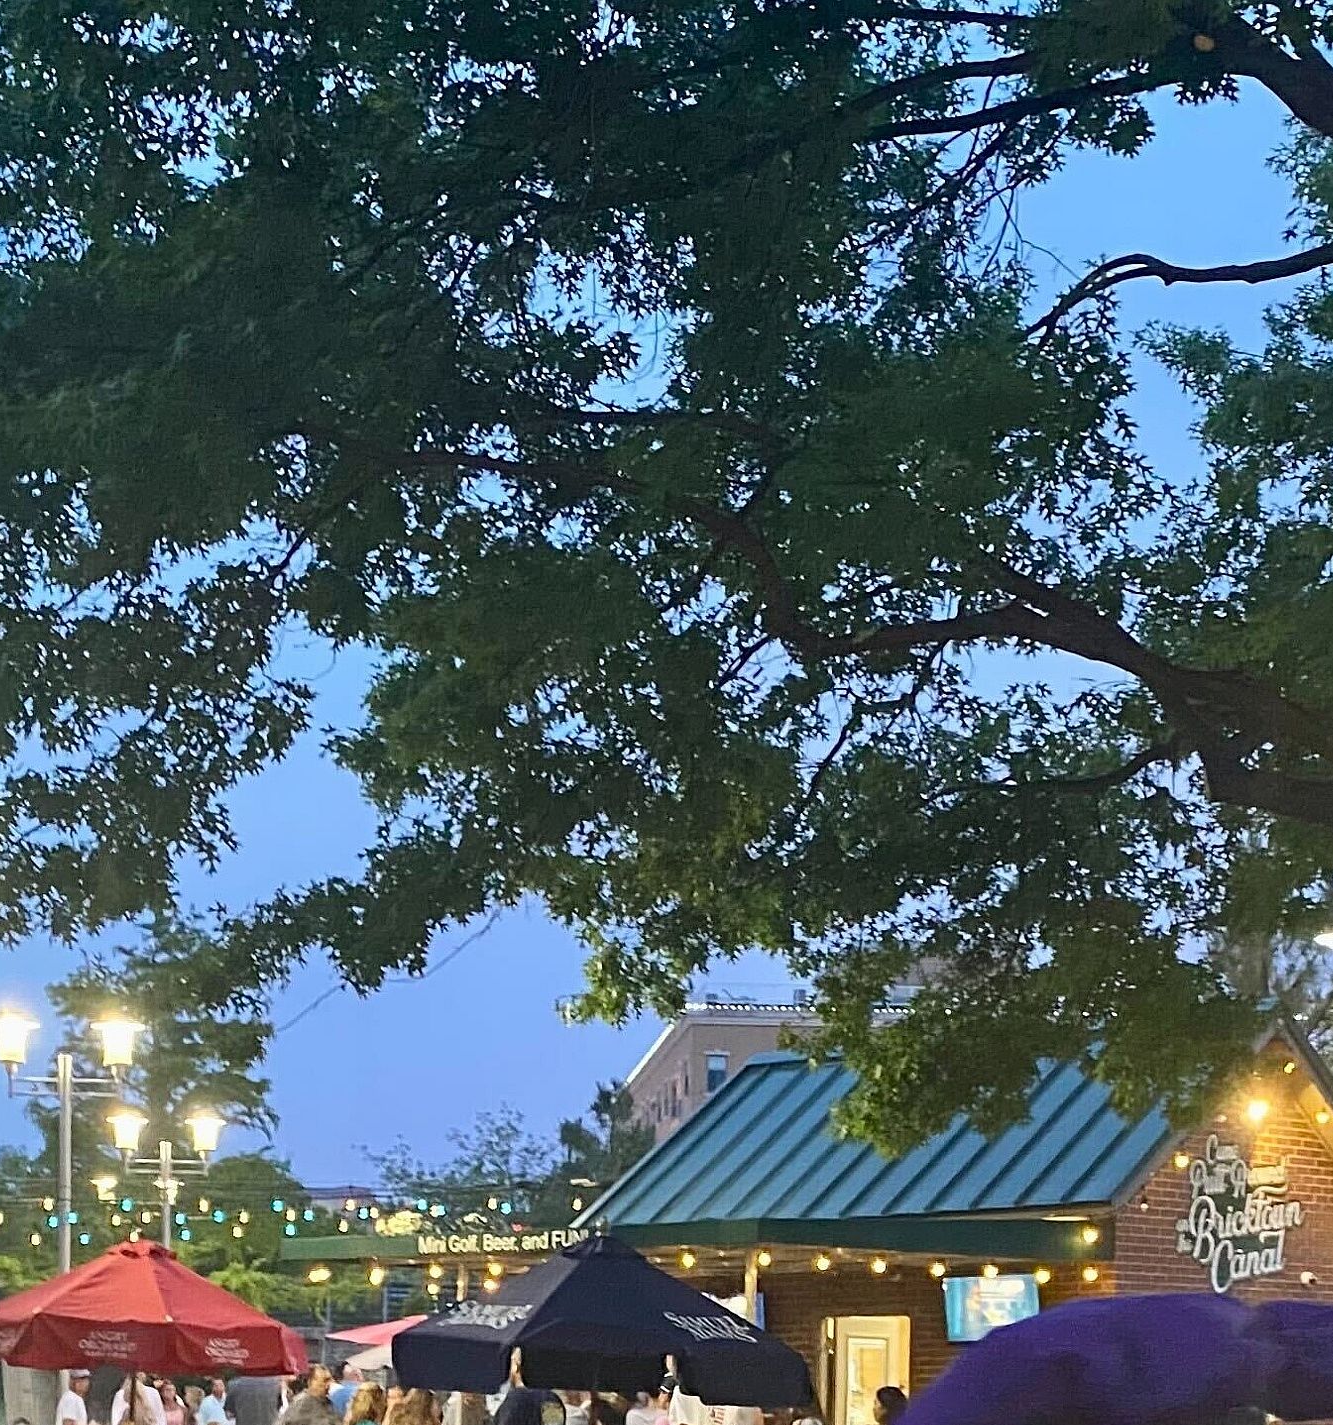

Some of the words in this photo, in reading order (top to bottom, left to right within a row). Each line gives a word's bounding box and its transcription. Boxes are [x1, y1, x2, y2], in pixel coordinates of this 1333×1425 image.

[418, 1235, 447, 1254] Mini
[482, 1233, 519, 1252] Beer,
[521, 1231, 549, 1251] and
[1210, 1229, 1286, 1293] Canal
